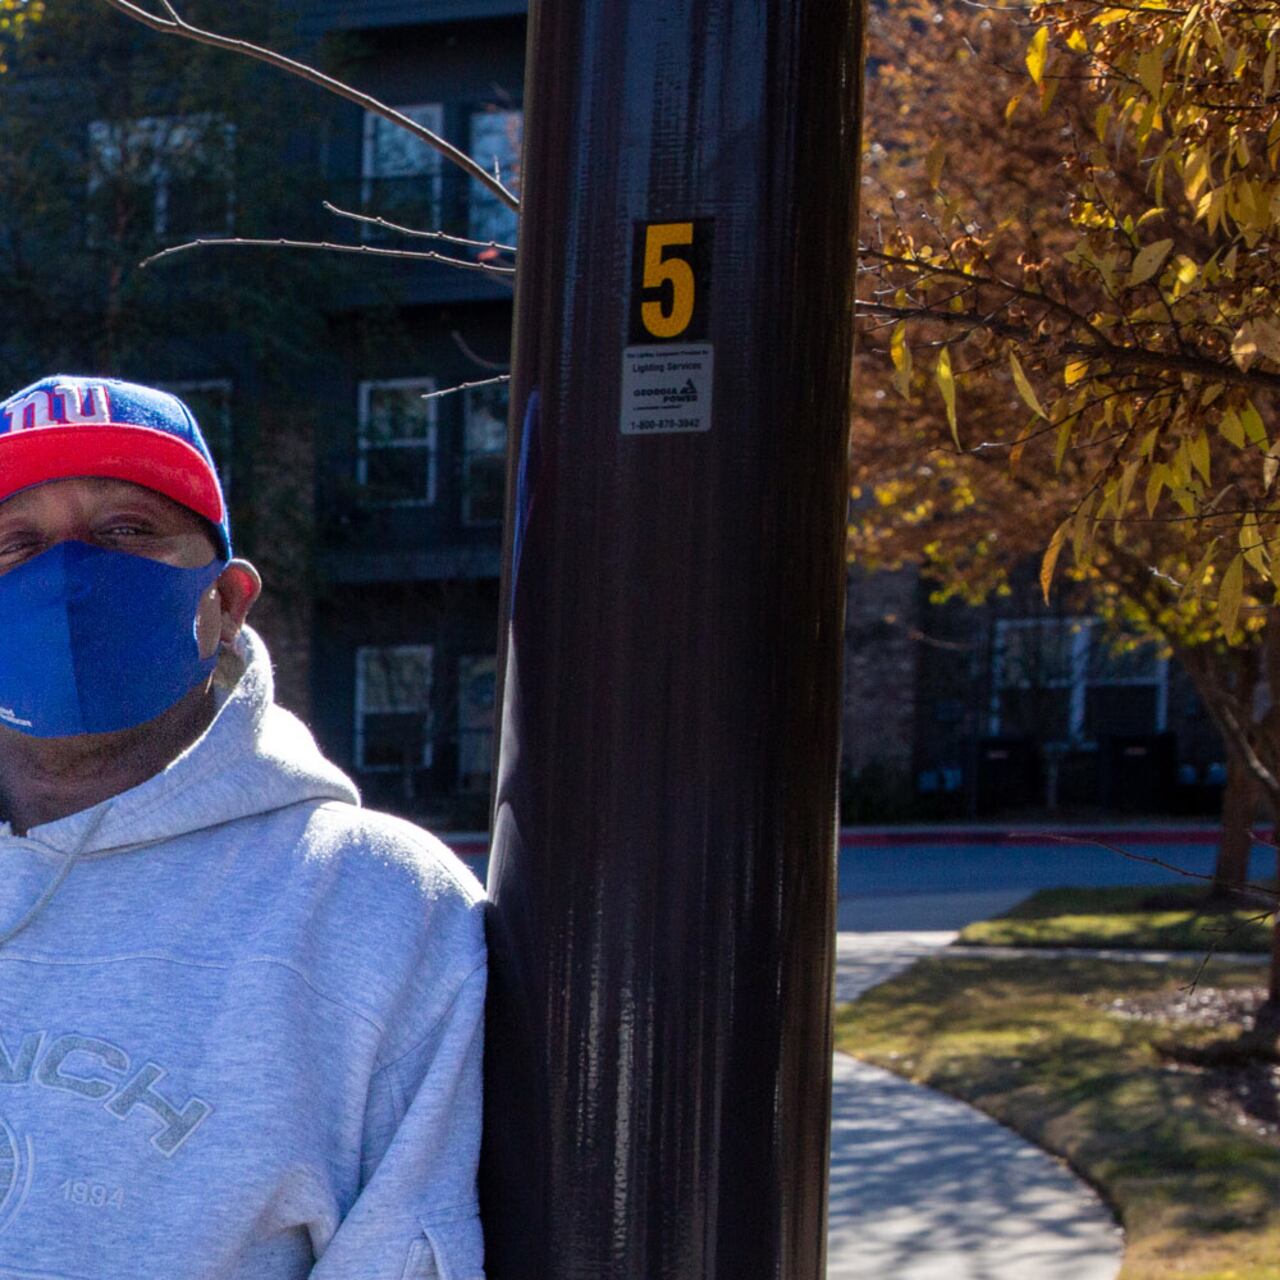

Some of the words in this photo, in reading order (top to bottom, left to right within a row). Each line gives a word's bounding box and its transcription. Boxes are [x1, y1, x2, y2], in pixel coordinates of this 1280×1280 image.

[641, 222, 695, 338] 5
[632, 363, 665, 374] Lighting
[666, 361, 702, 372] Services
[58, 1180, 126, 1211] 1994
